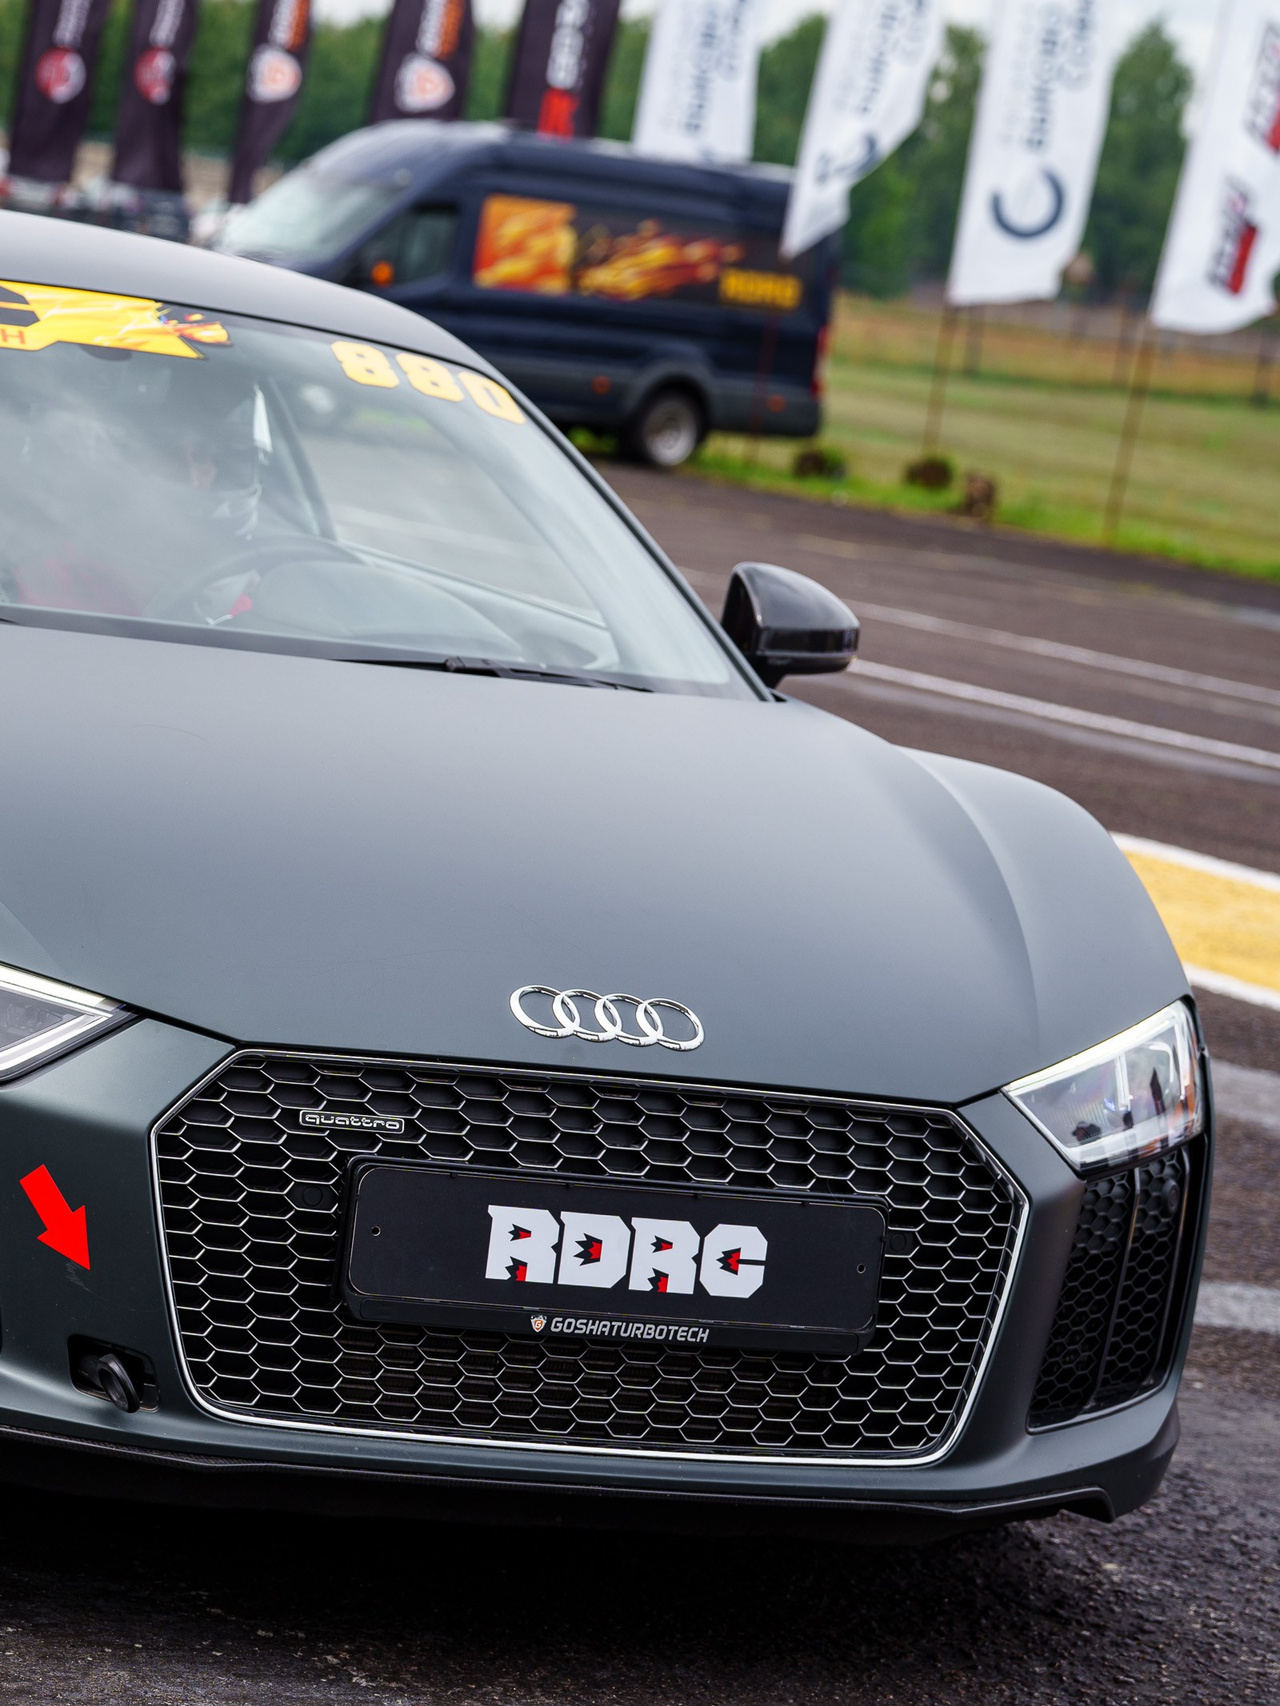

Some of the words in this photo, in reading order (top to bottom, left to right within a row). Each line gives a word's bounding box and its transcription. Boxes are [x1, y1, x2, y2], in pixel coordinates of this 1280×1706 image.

[330, 340, 527, 425] 880
[304, 1114, 400, 1130] quattro
[484, 1204, 768, 1299] RDRC
[550, 1317, 710, 1343] GOSHATURBOTECH
